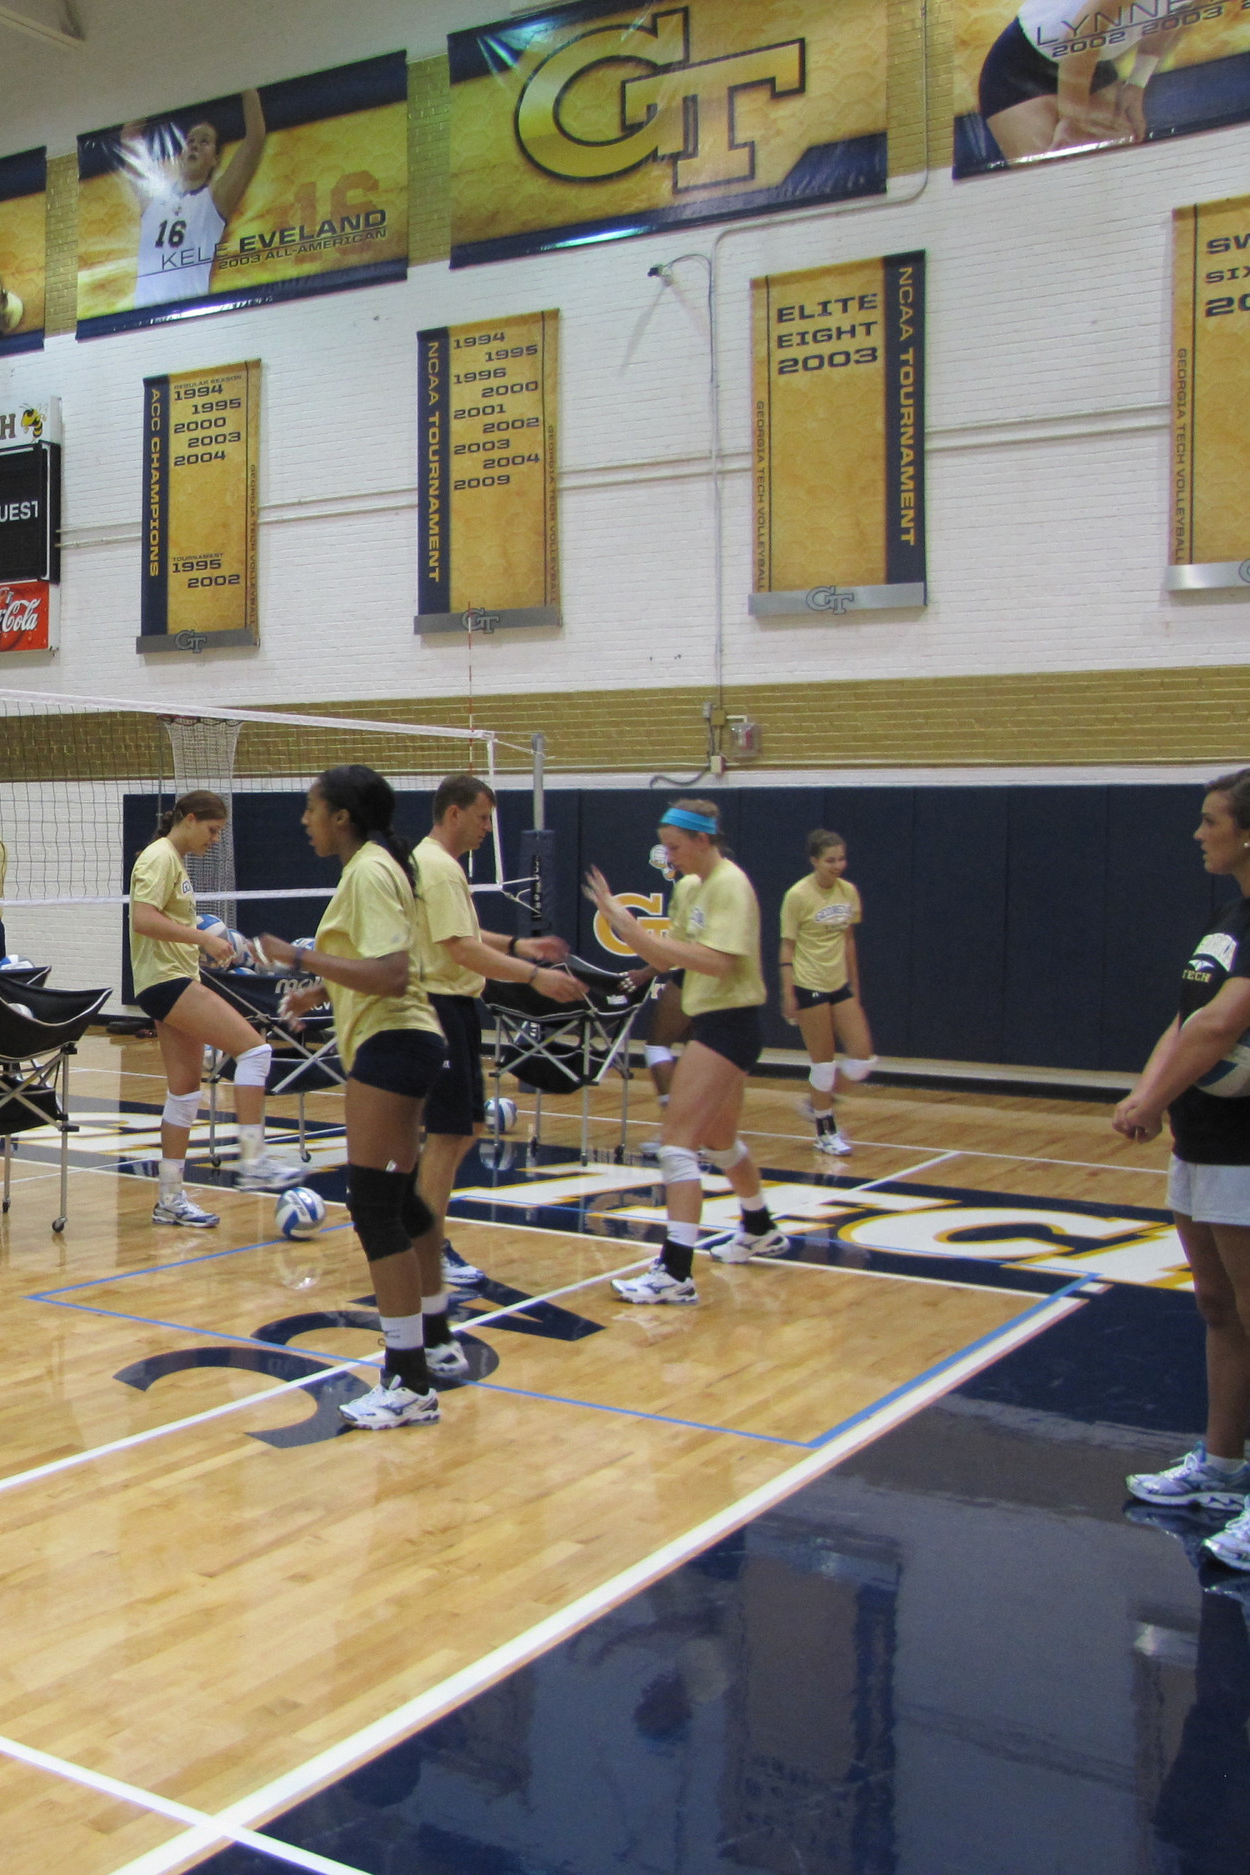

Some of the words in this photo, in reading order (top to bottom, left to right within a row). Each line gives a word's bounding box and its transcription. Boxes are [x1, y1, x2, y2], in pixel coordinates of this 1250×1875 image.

[1052, 31, 1126, 58] 2002
[1141, 5, 1223, 36] 2003
[514, 6, 806, 194] GT
[155, 219, 187, 249] 16
[161, 241, 230, 270] KELE
[239, 208, 387, 252] EVELAND
[218, 254, 261, 270] 2003
[265, 229, 387, 260] ALL-AMERICAN
[776, 293, 878, 324] ELITE
[898, 266, 913, 342] NCAA
[453, 331, 506, 349] 1994
[776, 321, 879, 349] EIGHT
[484, 344, 539, 363] 1995
[777, 347, 879, 376] 2003
[428, 341, 440, 406] NCAA
[453, 367, 507, 385] 1996
[1176, 347, 1186, 420] GEORGIA
[174, 384, 223, 401] 1994
[481, 380, 540, 399] 2000
[149, 388, 162, 432] ACC
[191, 397, 242, 415] 1995
[453, 403, 507, 421] 2001
[173, 416, 227, 434] 2000
[482, 417, 540, 434] 2002
[756, 400, 765, 465] GEORGIA
[187, 431, 241, 449] 2003
[453, 438, 511, 456] 2003
[899, 347, 916, 546] TOURNAMENT
[1176, 424, 1186, 464] TECH
[173, 450, 227, 467] 2004
[482, 453, 541, 470] 2004
[428, 411, 441, 583] TOURNAMENT
[453, 474, 511, 491] 2009
[757, 467, 766, 503] TECH
[148, 436, 161, 578] CHAMPIONS
[1175, 469, 1185, 565] VOLLEYBALL
[172, 553, 224, 563] TOURNAMENT
[757, 507, 766, 592] VOLLEYBALL
[171, 559, 222, 574] 1995
[187, 574, 241, 589] 2002
